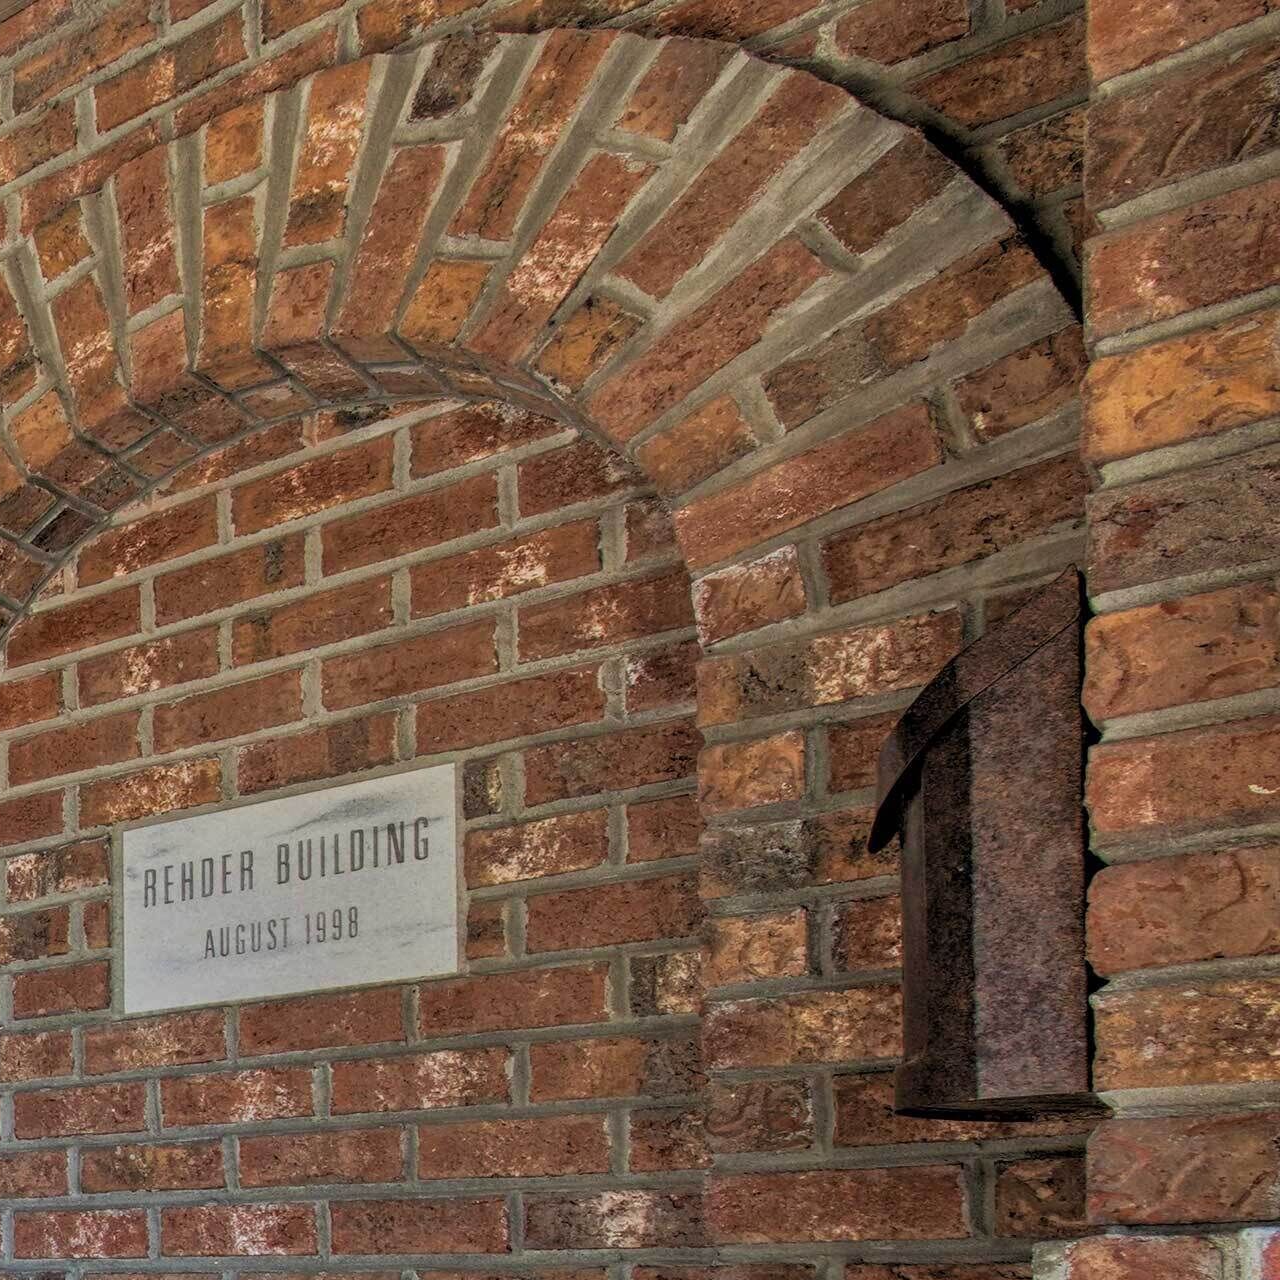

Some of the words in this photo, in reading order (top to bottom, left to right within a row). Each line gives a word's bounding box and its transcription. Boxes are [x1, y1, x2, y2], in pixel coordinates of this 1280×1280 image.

[143, 849, 255, 908] REHDER
[276, 816, 430, 885] BUILDING
[203, 916, 291, 959] AUGUST
[305, 905, 359, 945] 1998
